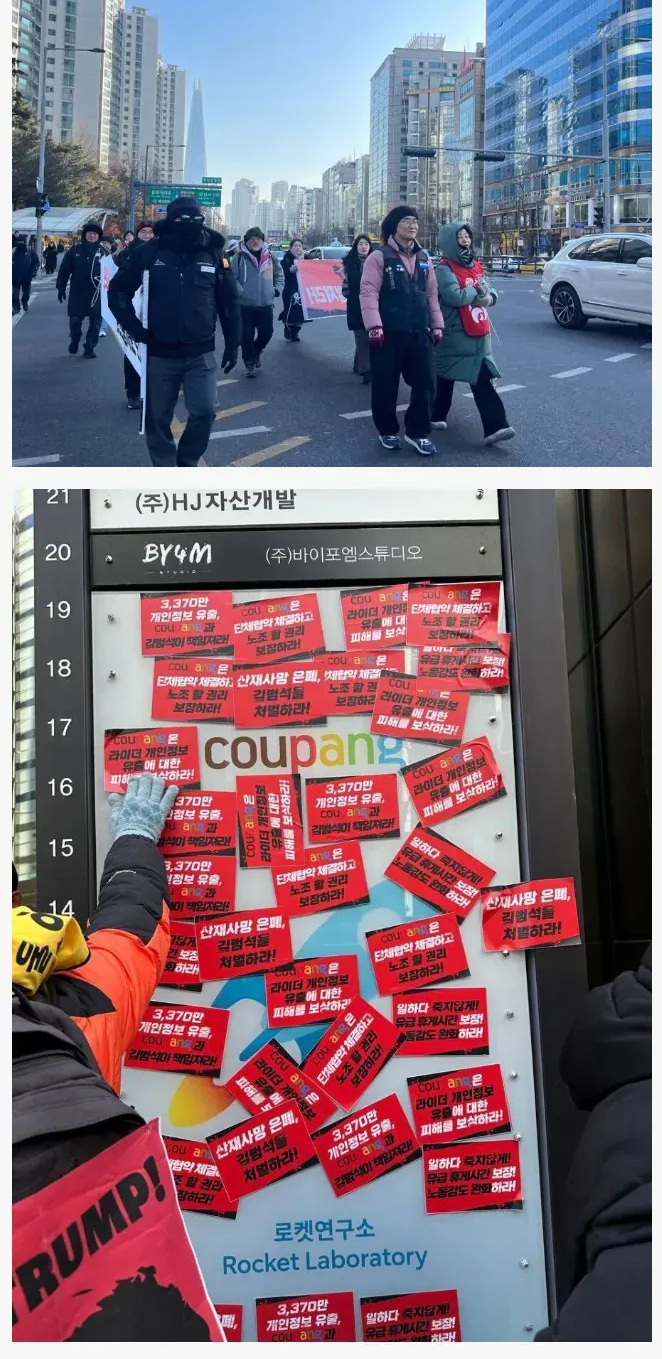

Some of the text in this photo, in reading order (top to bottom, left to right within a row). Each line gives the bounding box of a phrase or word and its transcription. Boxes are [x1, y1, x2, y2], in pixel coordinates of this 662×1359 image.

[46, 489, 70, 505] 21
[45, 543, 71, 561] 20
[142, 541, 212, 566] BY4M
[265, 545, 423, 565] (주)바이포엠스튜디오
[46, 600, 71, 619] 19
[160, 597, 208, 609] 3,370만
[150, 608, 220, 623] 개인정보 유출,
[234, 611, 314, 634] 단체협약 체결하고
[255, 640, 301, 657] 보장하라!
[46, 659, 72, 677] 18
[237, 669, 321, 688] 산재사망 은폐,
[253, 702, 311, 719] 처벌하라!
[48, 718, 72, 736] 17
[204, 732, 407, 777] coupang
[48, 778, 73, 796] 16
[48, 838, 74, 857] 15
[48, 900, 75, 917] 14
[415, 1085, 495, 1111] 라이더 개인정보
[466, 1100, 488, 1114] 대한
[428, 1157, 461, 1171] 일하다
[427, 1173, 448, 1184] 유급
[491, 1166, 516, 1179] 보장!
[273, 1218, 376, 1243] 로켓연구소
[12, 1156, 166, 1326] RUMP!
[223, 1248, 428, 1275] Rocket Laboratory
[276, 1298, 329, 1316] 3,370만
[266, 1313, 341, 1332] 개인정보 유출,
